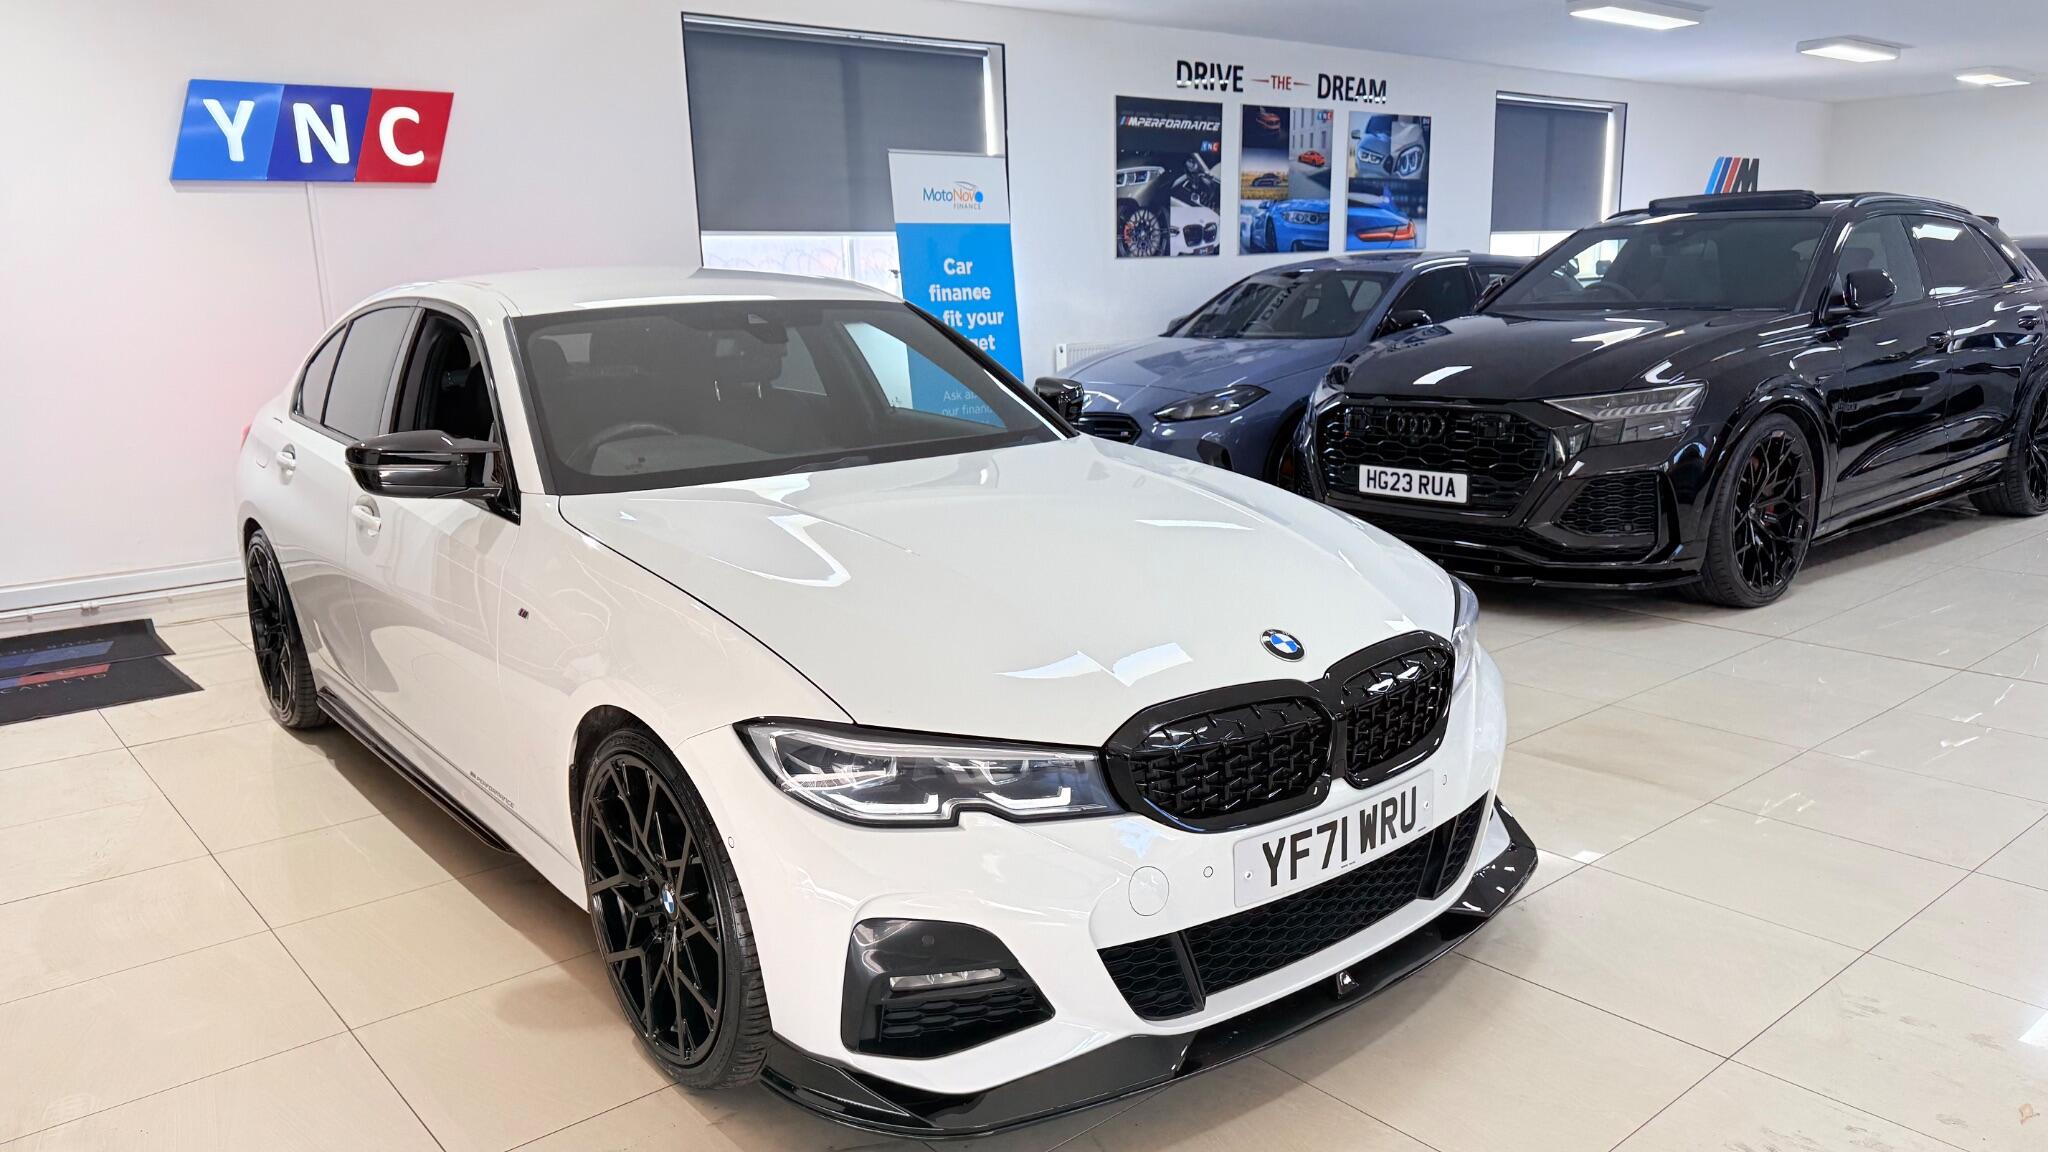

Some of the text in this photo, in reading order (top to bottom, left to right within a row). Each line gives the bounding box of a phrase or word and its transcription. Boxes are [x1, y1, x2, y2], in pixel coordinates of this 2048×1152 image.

[1176, 60, 1387, 104] DRIVE THE DREAM
[203, 98, 425, 166] YNC
[943, 257, 974, 275] Car
[928, 283, 992, 303] finance
[942, 309, 1004, 330] fit your
[943, 389, 962, 401] Ask
[1366, 468, 1457, 498] HG23 RUA
[1262, 785, 1417, 887] YF71 WRU
